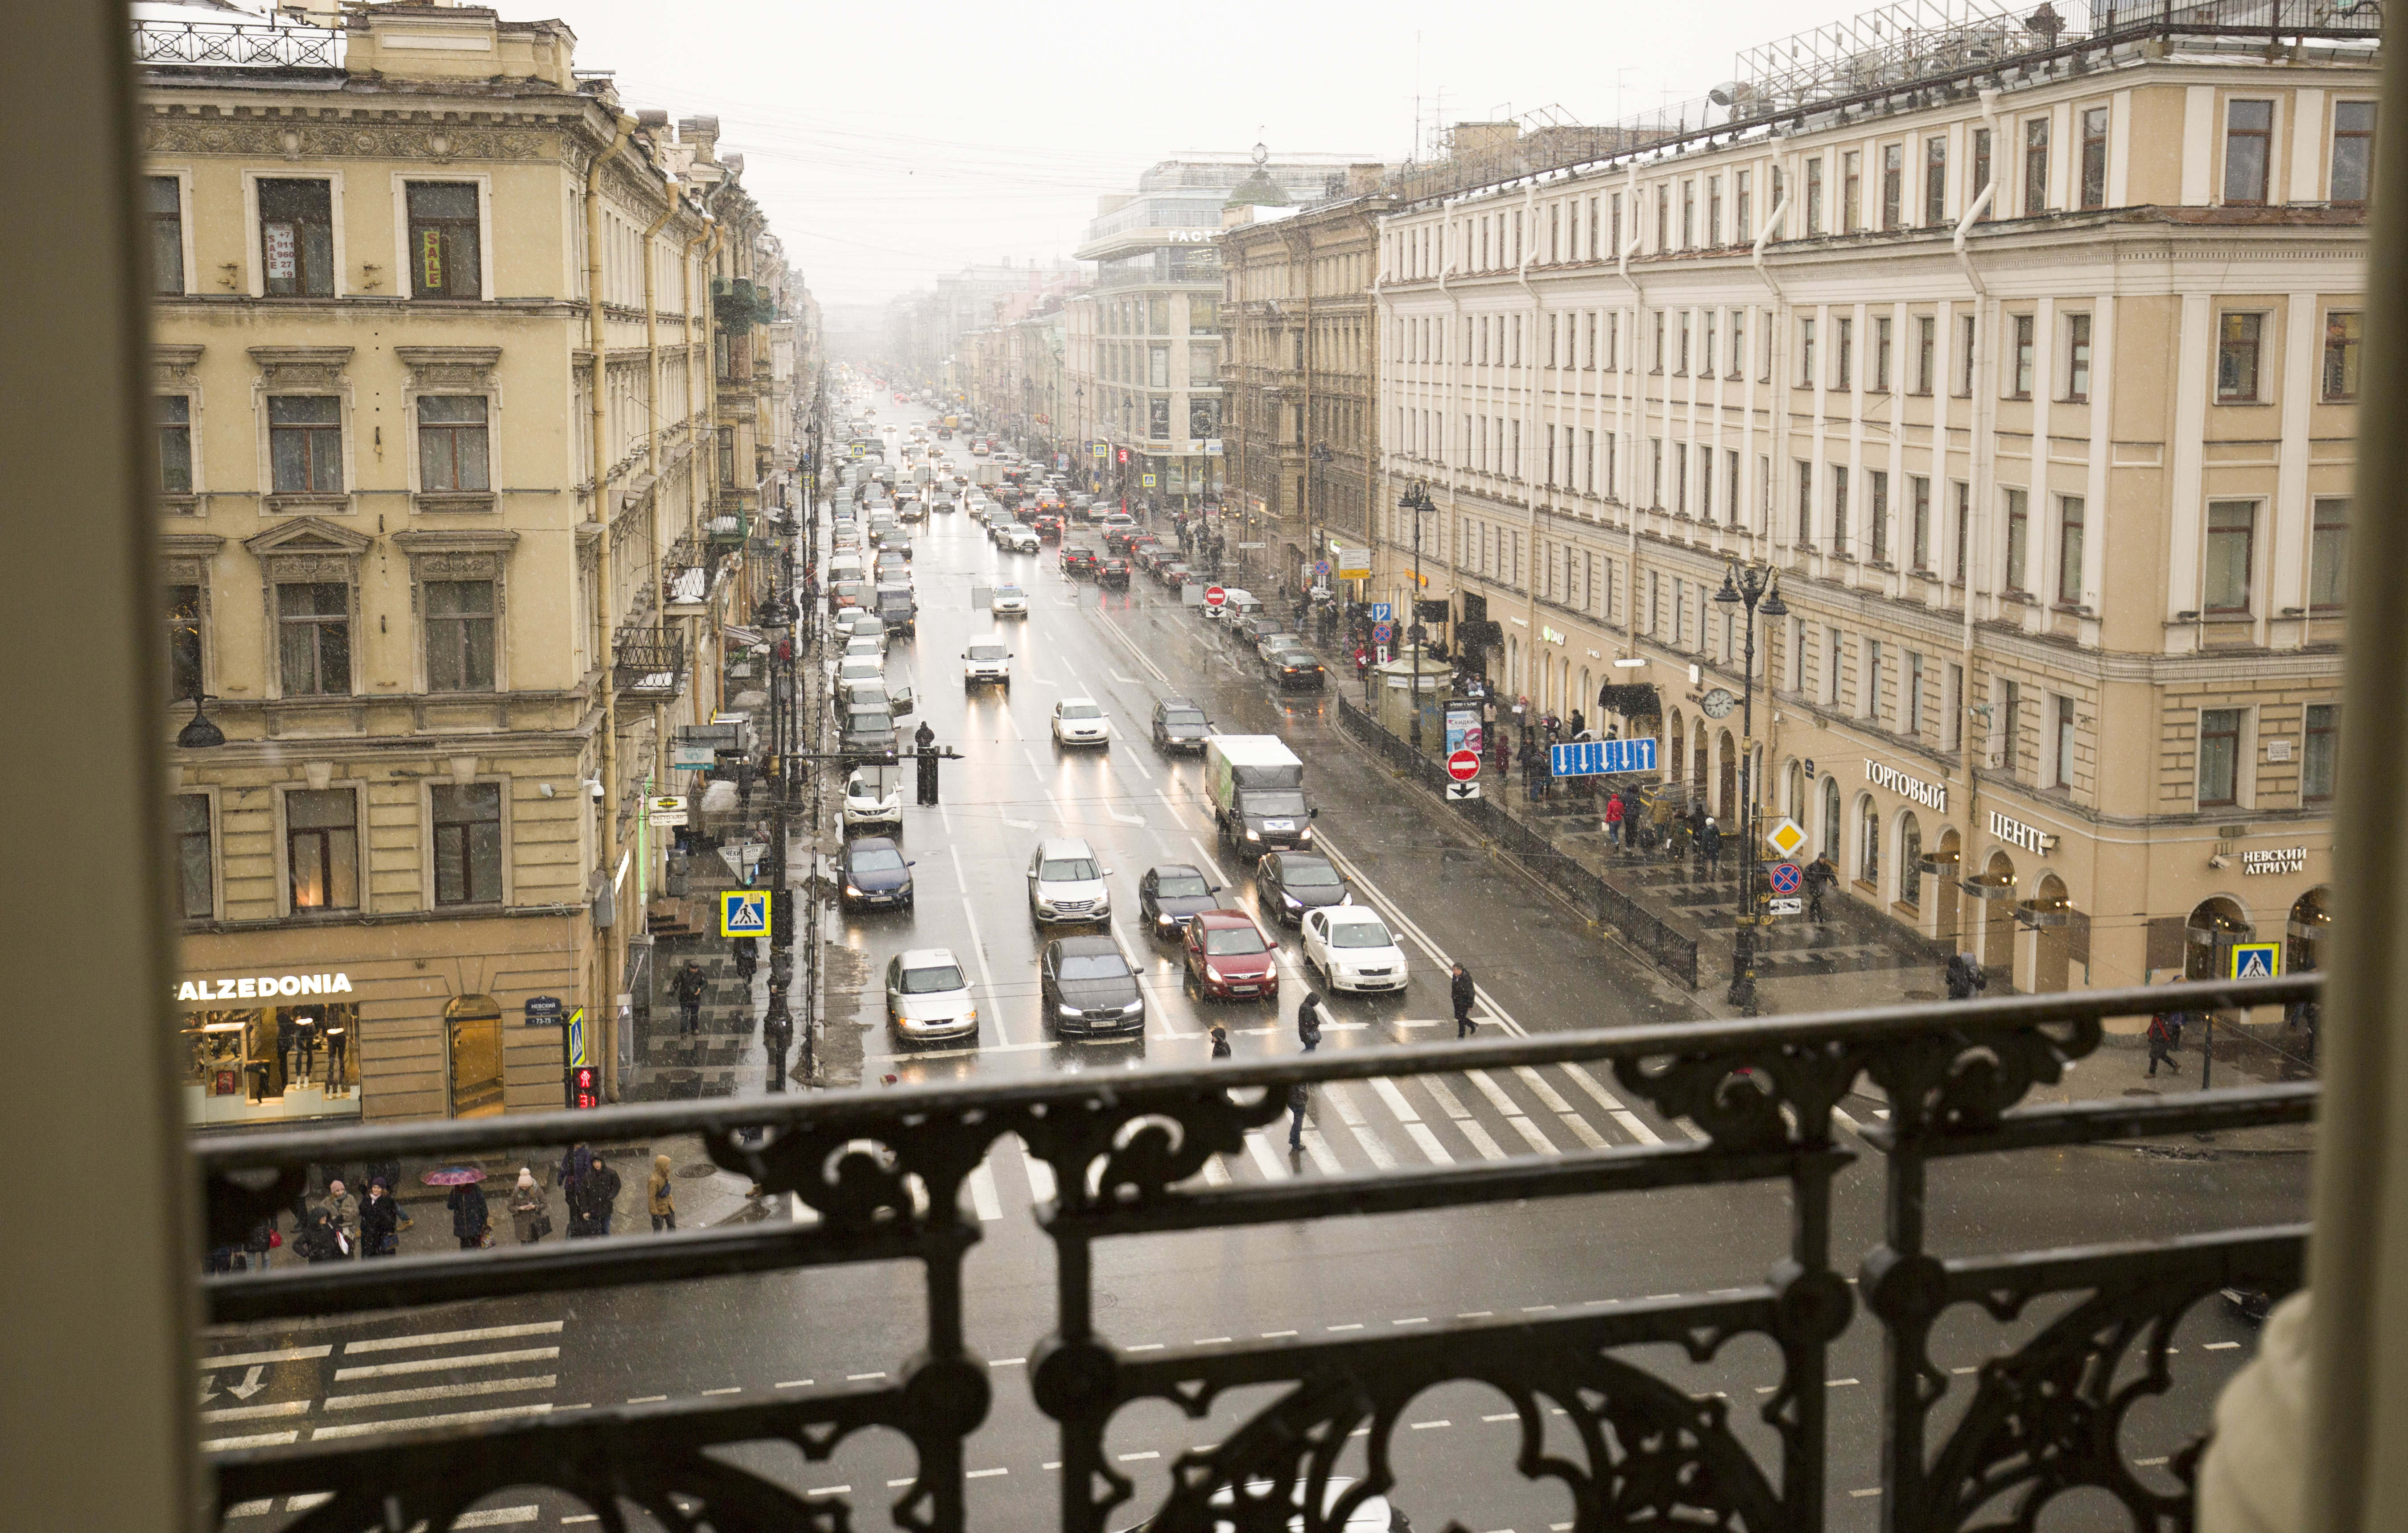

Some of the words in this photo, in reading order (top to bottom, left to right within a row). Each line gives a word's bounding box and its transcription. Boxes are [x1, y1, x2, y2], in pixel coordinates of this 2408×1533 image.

[1169, 231, 1222, 242] ГАСТ
[268, 235, 277, 269] SALE
[427, 233, 439, 284] SALE
[1550, 629, 1566, 646] DAILY
[1864, 758, 1946, 813] ТОРГОВЫЙ
[2243, 845, 2307, 863] НЕВСКИЙ
[2246, 860, 2302, 875] АТРИУМ
[579, 1094, 595, 1108] 31
